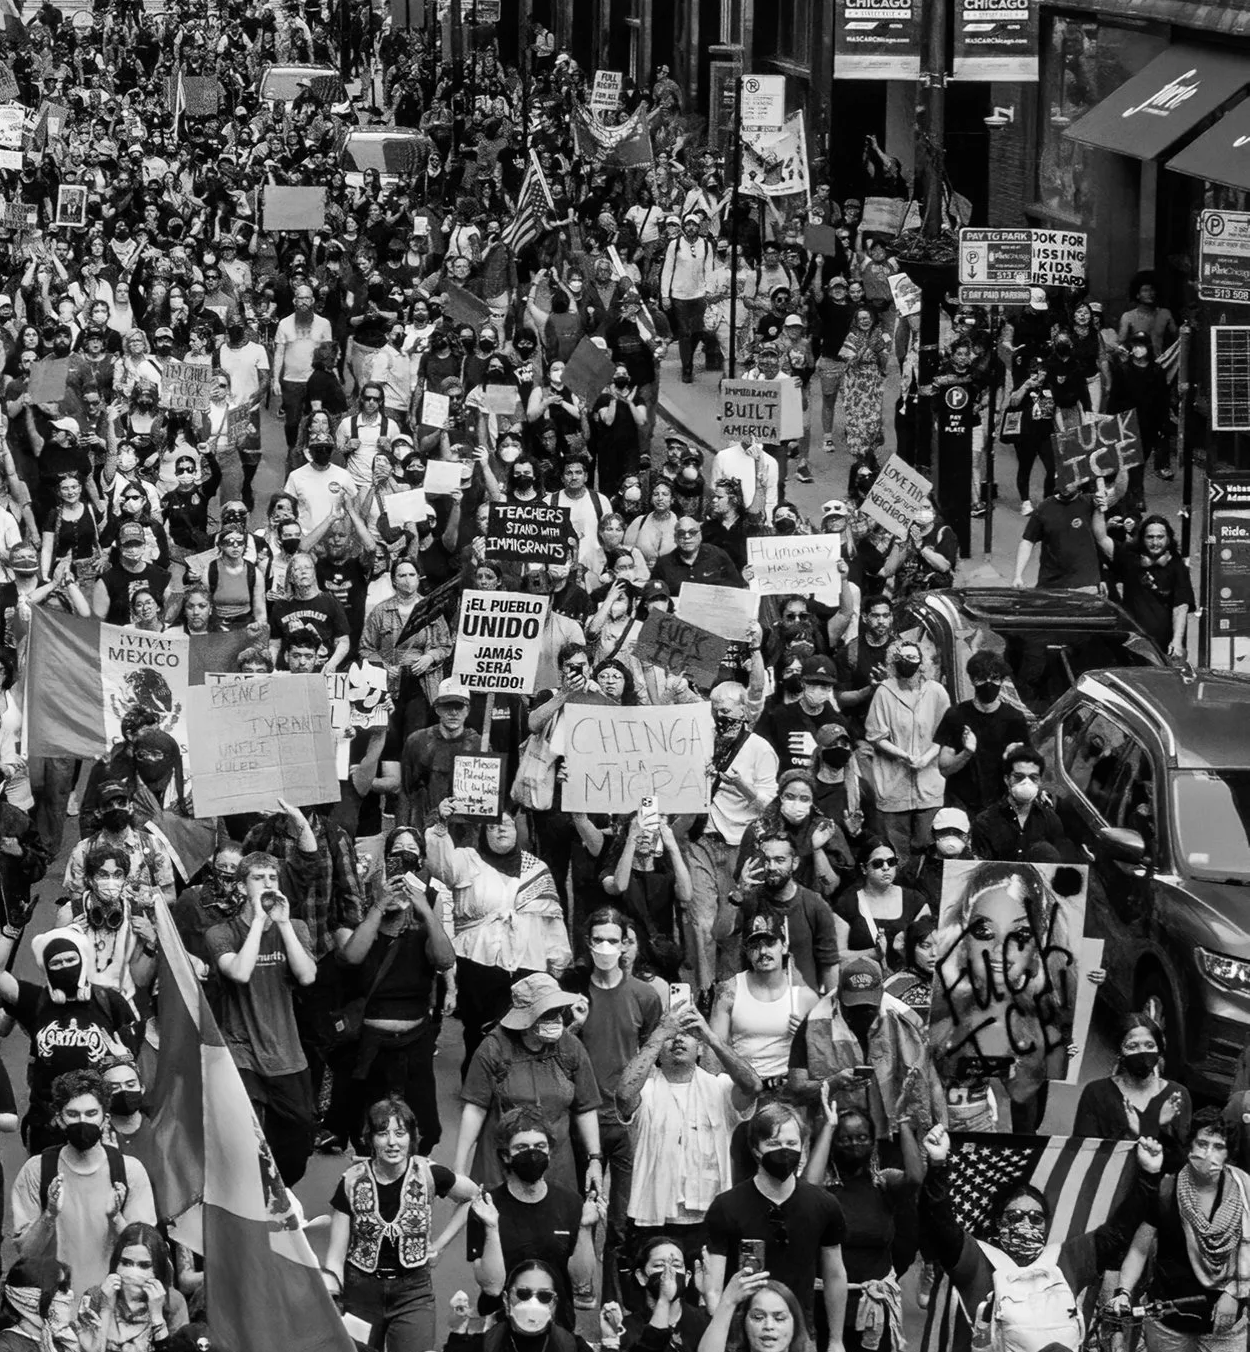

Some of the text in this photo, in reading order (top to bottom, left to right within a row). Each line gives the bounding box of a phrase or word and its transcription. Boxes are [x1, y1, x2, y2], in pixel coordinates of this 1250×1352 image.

[1062, 234, 1084, 247] FOR
[1038, 262, 1073, 274] KIDS
[1051, 274, 1086, 286] HARD
[724, 401, 777, 420] BUILT
[723, 426, 777, 438] AMERICA
[884, 462, 926, 504] LOVE THY
[495, 506, 564, 523] TEACHERS
[506, 522, 560, 537] STAND WITH
[486, 537, 565, 559] IMMIGRANTS
[797, 561, 813, 573] NO
[465, 598, 543, 615] ¡EL PUEBLO
[462, 614, 540, 640] UNIDO
[119, 634, 173, 651] ¡VIVA!
[108, 647, 180, 668] MEXICO
[474, 645, 524, 661] JAMÁS
[475, 659, 512, 675] SERÁ
[459, 673, 524, 689] VENCIDO!
[570, 717, 702, 756] CHINGA
